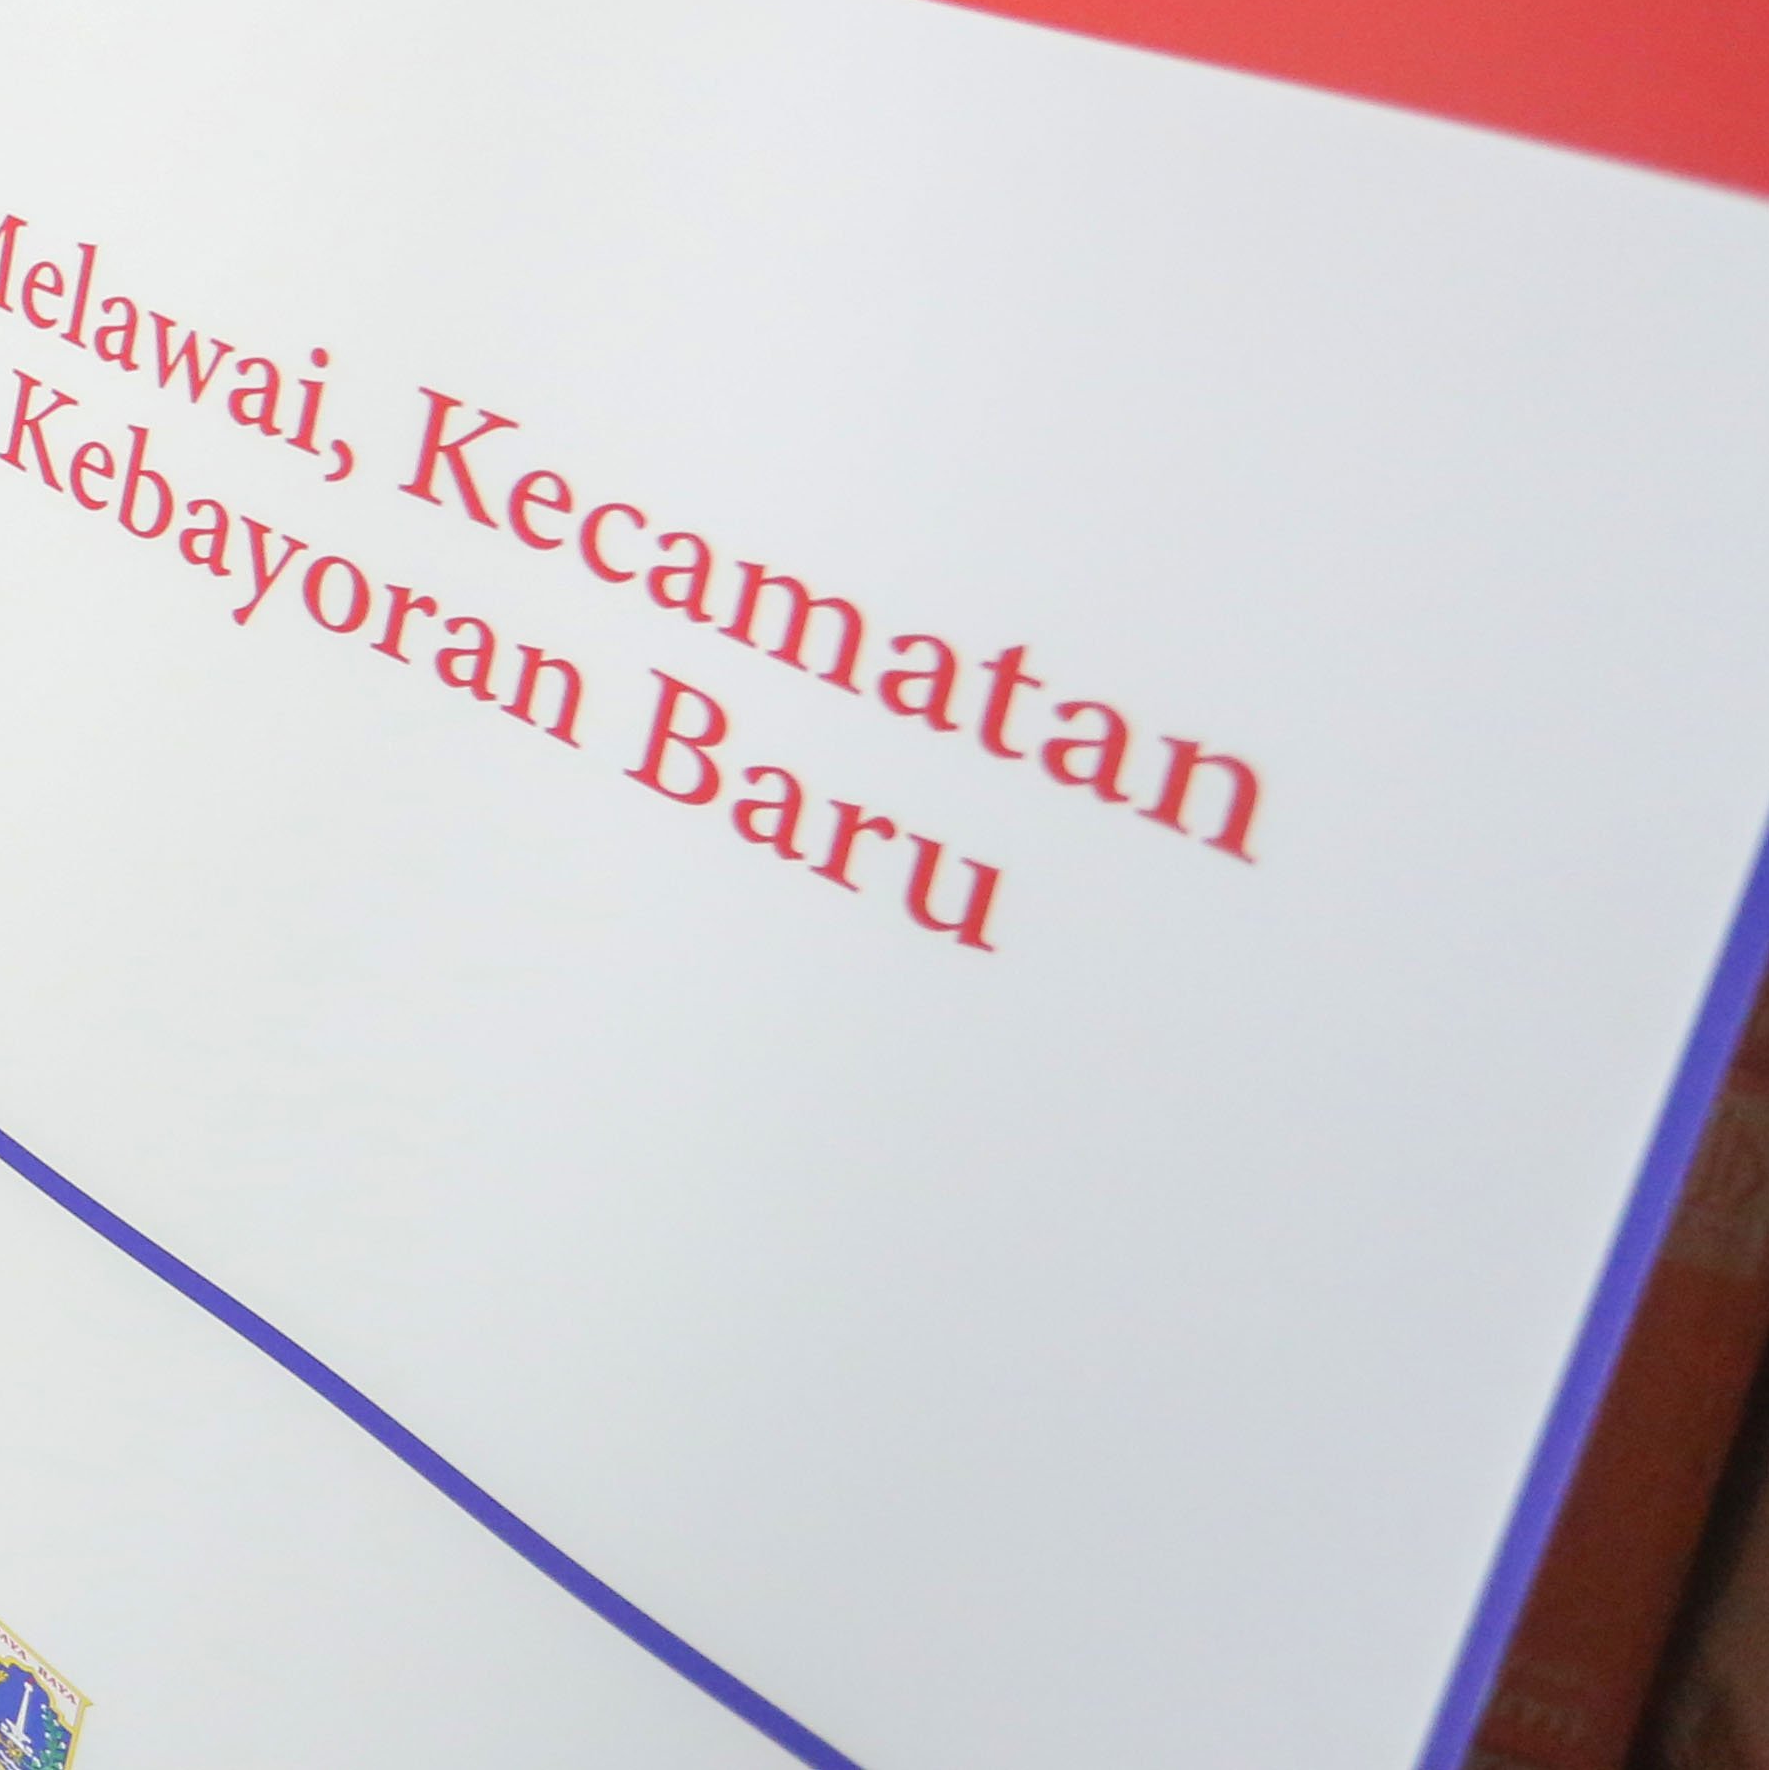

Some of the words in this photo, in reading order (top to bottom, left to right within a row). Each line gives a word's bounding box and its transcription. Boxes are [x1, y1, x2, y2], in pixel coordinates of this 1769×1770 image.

[399, 384, 1264, 866] Kecamatan
[624, 665, 1004, 953] Baru
[38, 1666, 78, 1705] RAYA
